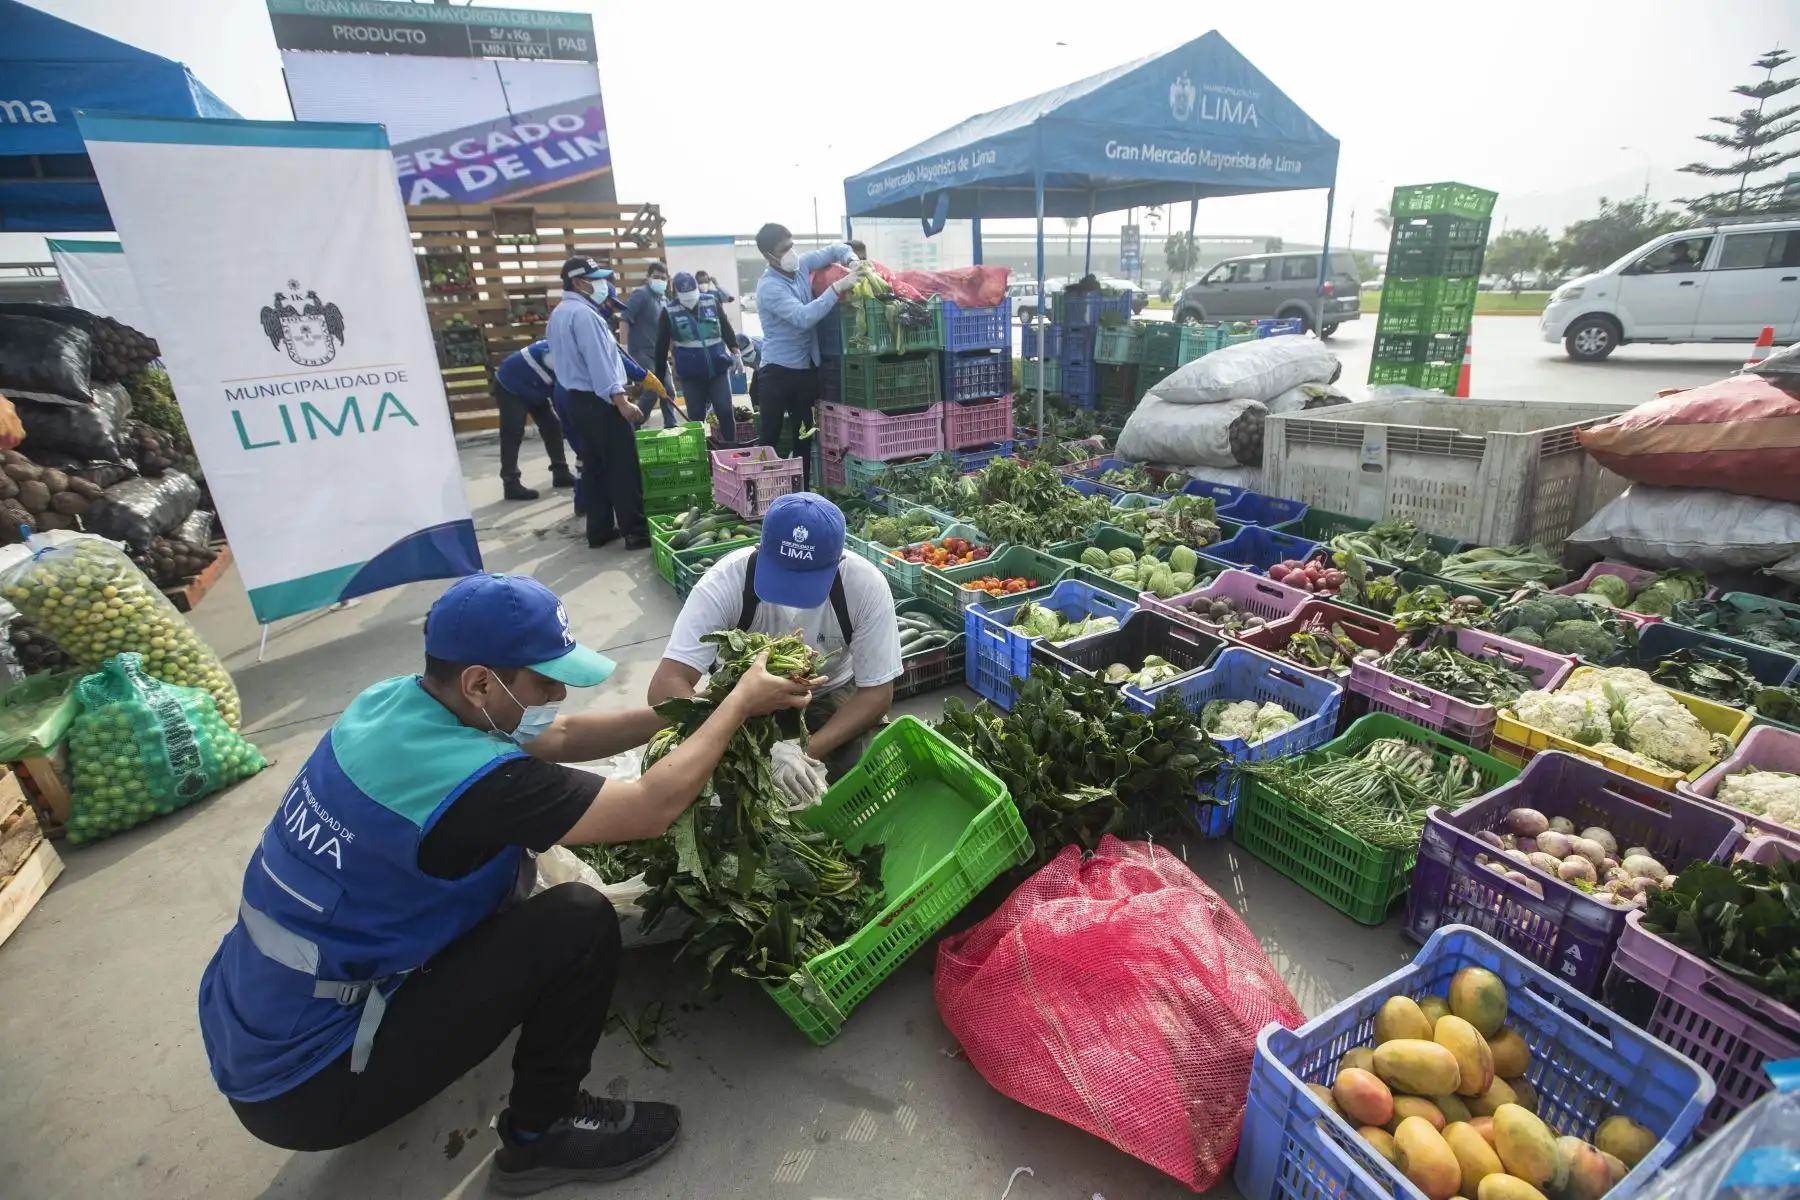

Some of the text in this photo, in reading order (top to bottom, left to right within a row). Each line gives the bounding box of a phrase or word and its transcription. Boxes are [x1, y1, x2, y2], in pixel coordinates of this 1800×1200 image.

[305, 1, 564, 26] GRAN MERCADO MAYORISTA DE LIMA
[331, 24, 427, 44] PRODUCTO
[481, 43, 506, 56] MIN
[557, 37, 588, 51] PAB
[516, 46, 546, 57] MAX
[1201, 95, 1259, 128] LIMA
[867, 149, 996, 196] Gran Mercado Mayorista de Lima
[1105, 140, 1302, 173] Gran Mercado Mayorista de Lima
[455, 154, 531, 192] DE
[224, 370, 409, 402] MUNICIPALIDAD DE
[231, 391, 419, 450] LIMA
[780, 545, 813, 560] LIMA
[302, 776, 356, 844] MUNICIPALIDAD DE
[284, 786, 342, 869] LIMA
